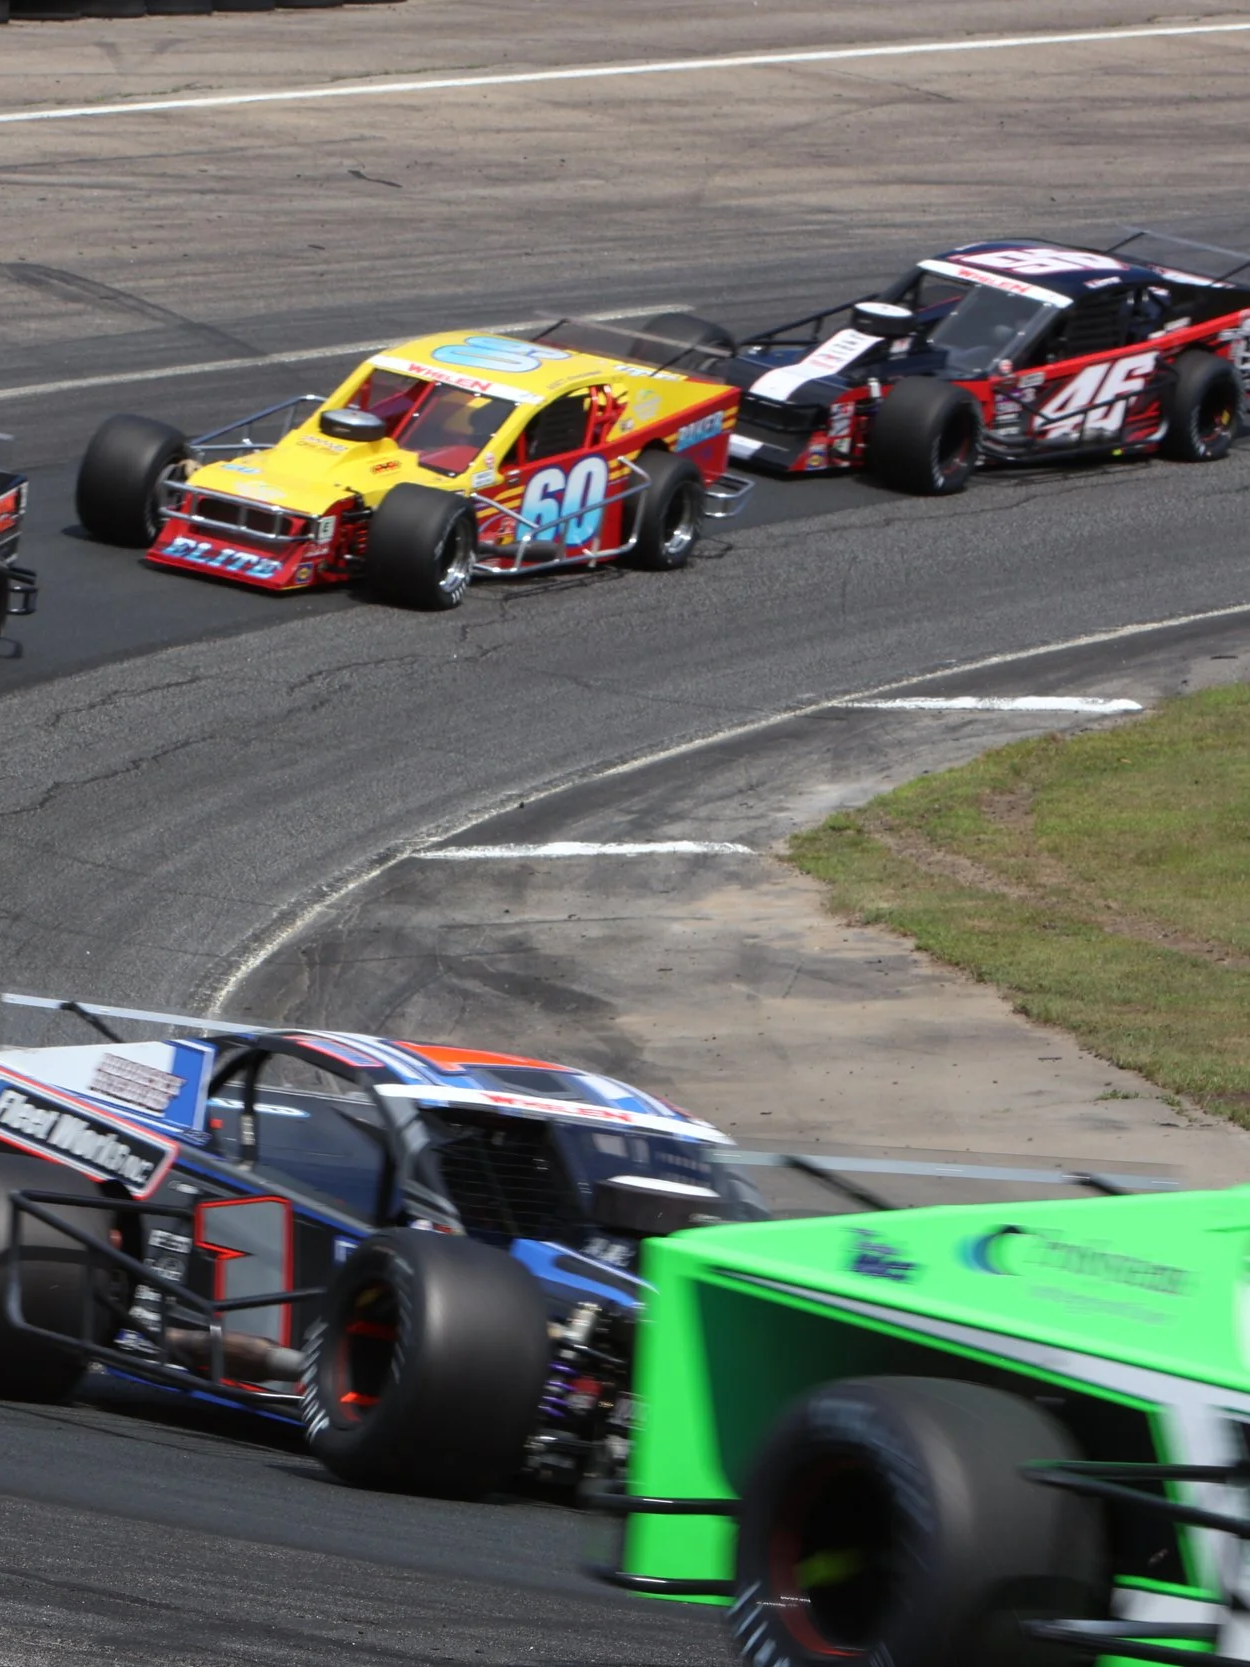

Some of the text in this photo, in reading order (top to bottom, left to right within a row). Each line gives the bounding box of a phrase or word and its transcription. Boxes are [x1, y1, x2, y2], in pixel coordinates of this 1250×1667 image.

[407, 363, 493, 391] WHELEN
[515, 453, 609, 546] 60
[161, 535, 283, 579] ELITE
[46, 1112, 131, 1171] Works
